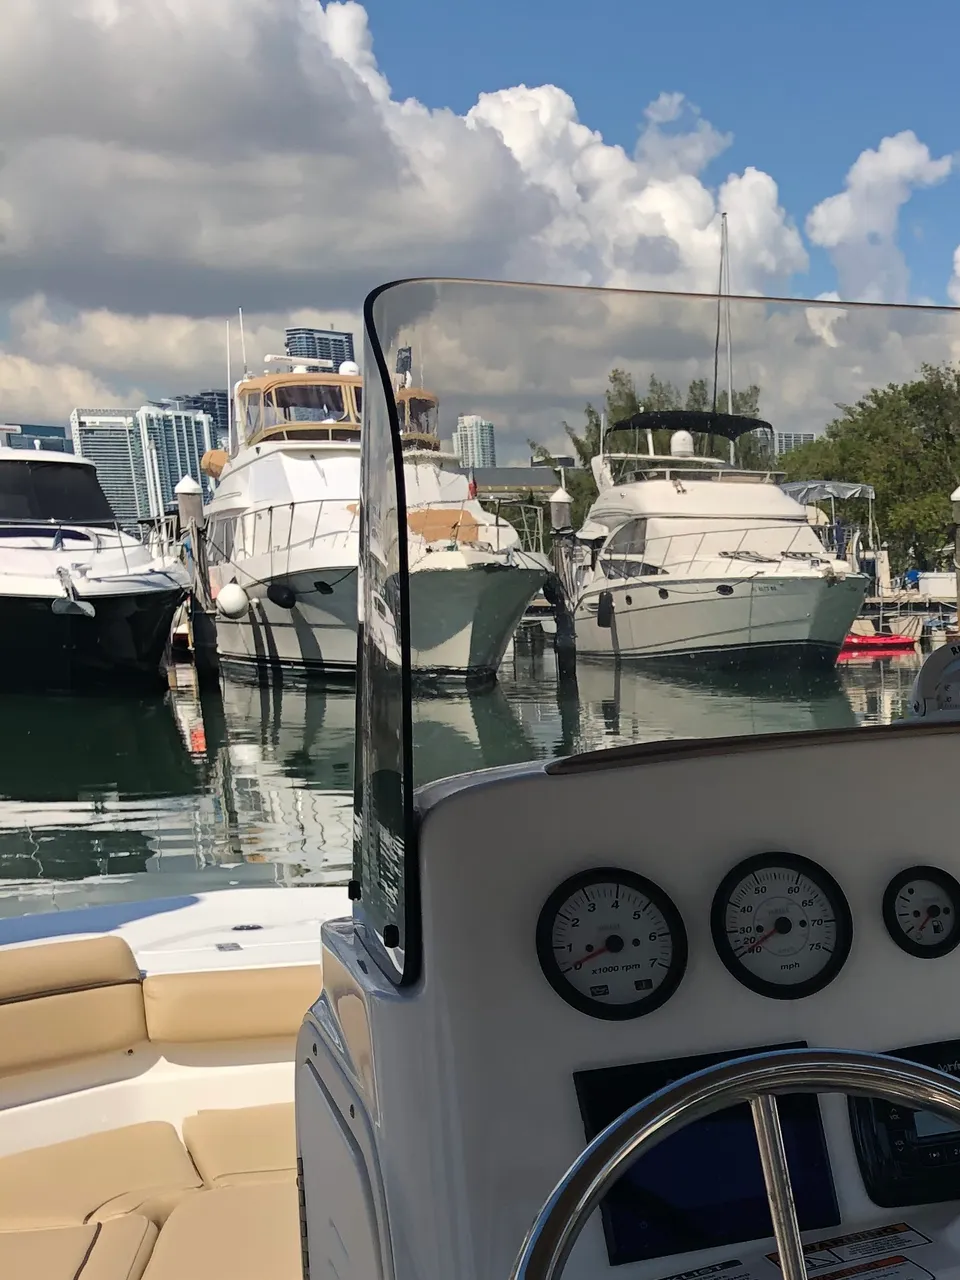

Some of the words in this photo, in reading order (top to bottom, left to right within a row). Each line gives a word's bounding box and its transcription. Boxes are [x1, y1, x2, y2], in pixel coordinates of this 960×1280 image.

[754, 886, 767, 895] 50
[788, 886, 800, 894] 60
[588, 903, 596, 912] 3
[611, 901, 620, 909] 4
[802, 900, 814, 908] 65
[740, 905, 753, 914] 40
[633, 911, 641, 920] 5
[572, 918, 580, 928] 2
[739, 926, 752, 934] 30
[649, 932, 656, 941] 6
[743, 937, 756, 945] 20
[567, 944, 573, 952] 1
[809, 942, 822, 951] 75
[574, 962, 582, 970] 0
[649, 958, 658, 968] 7
[780, 962, 800, 972] mph
[591, 966, 619, 976] x1000
[622, 964, 641, 973] rpm
